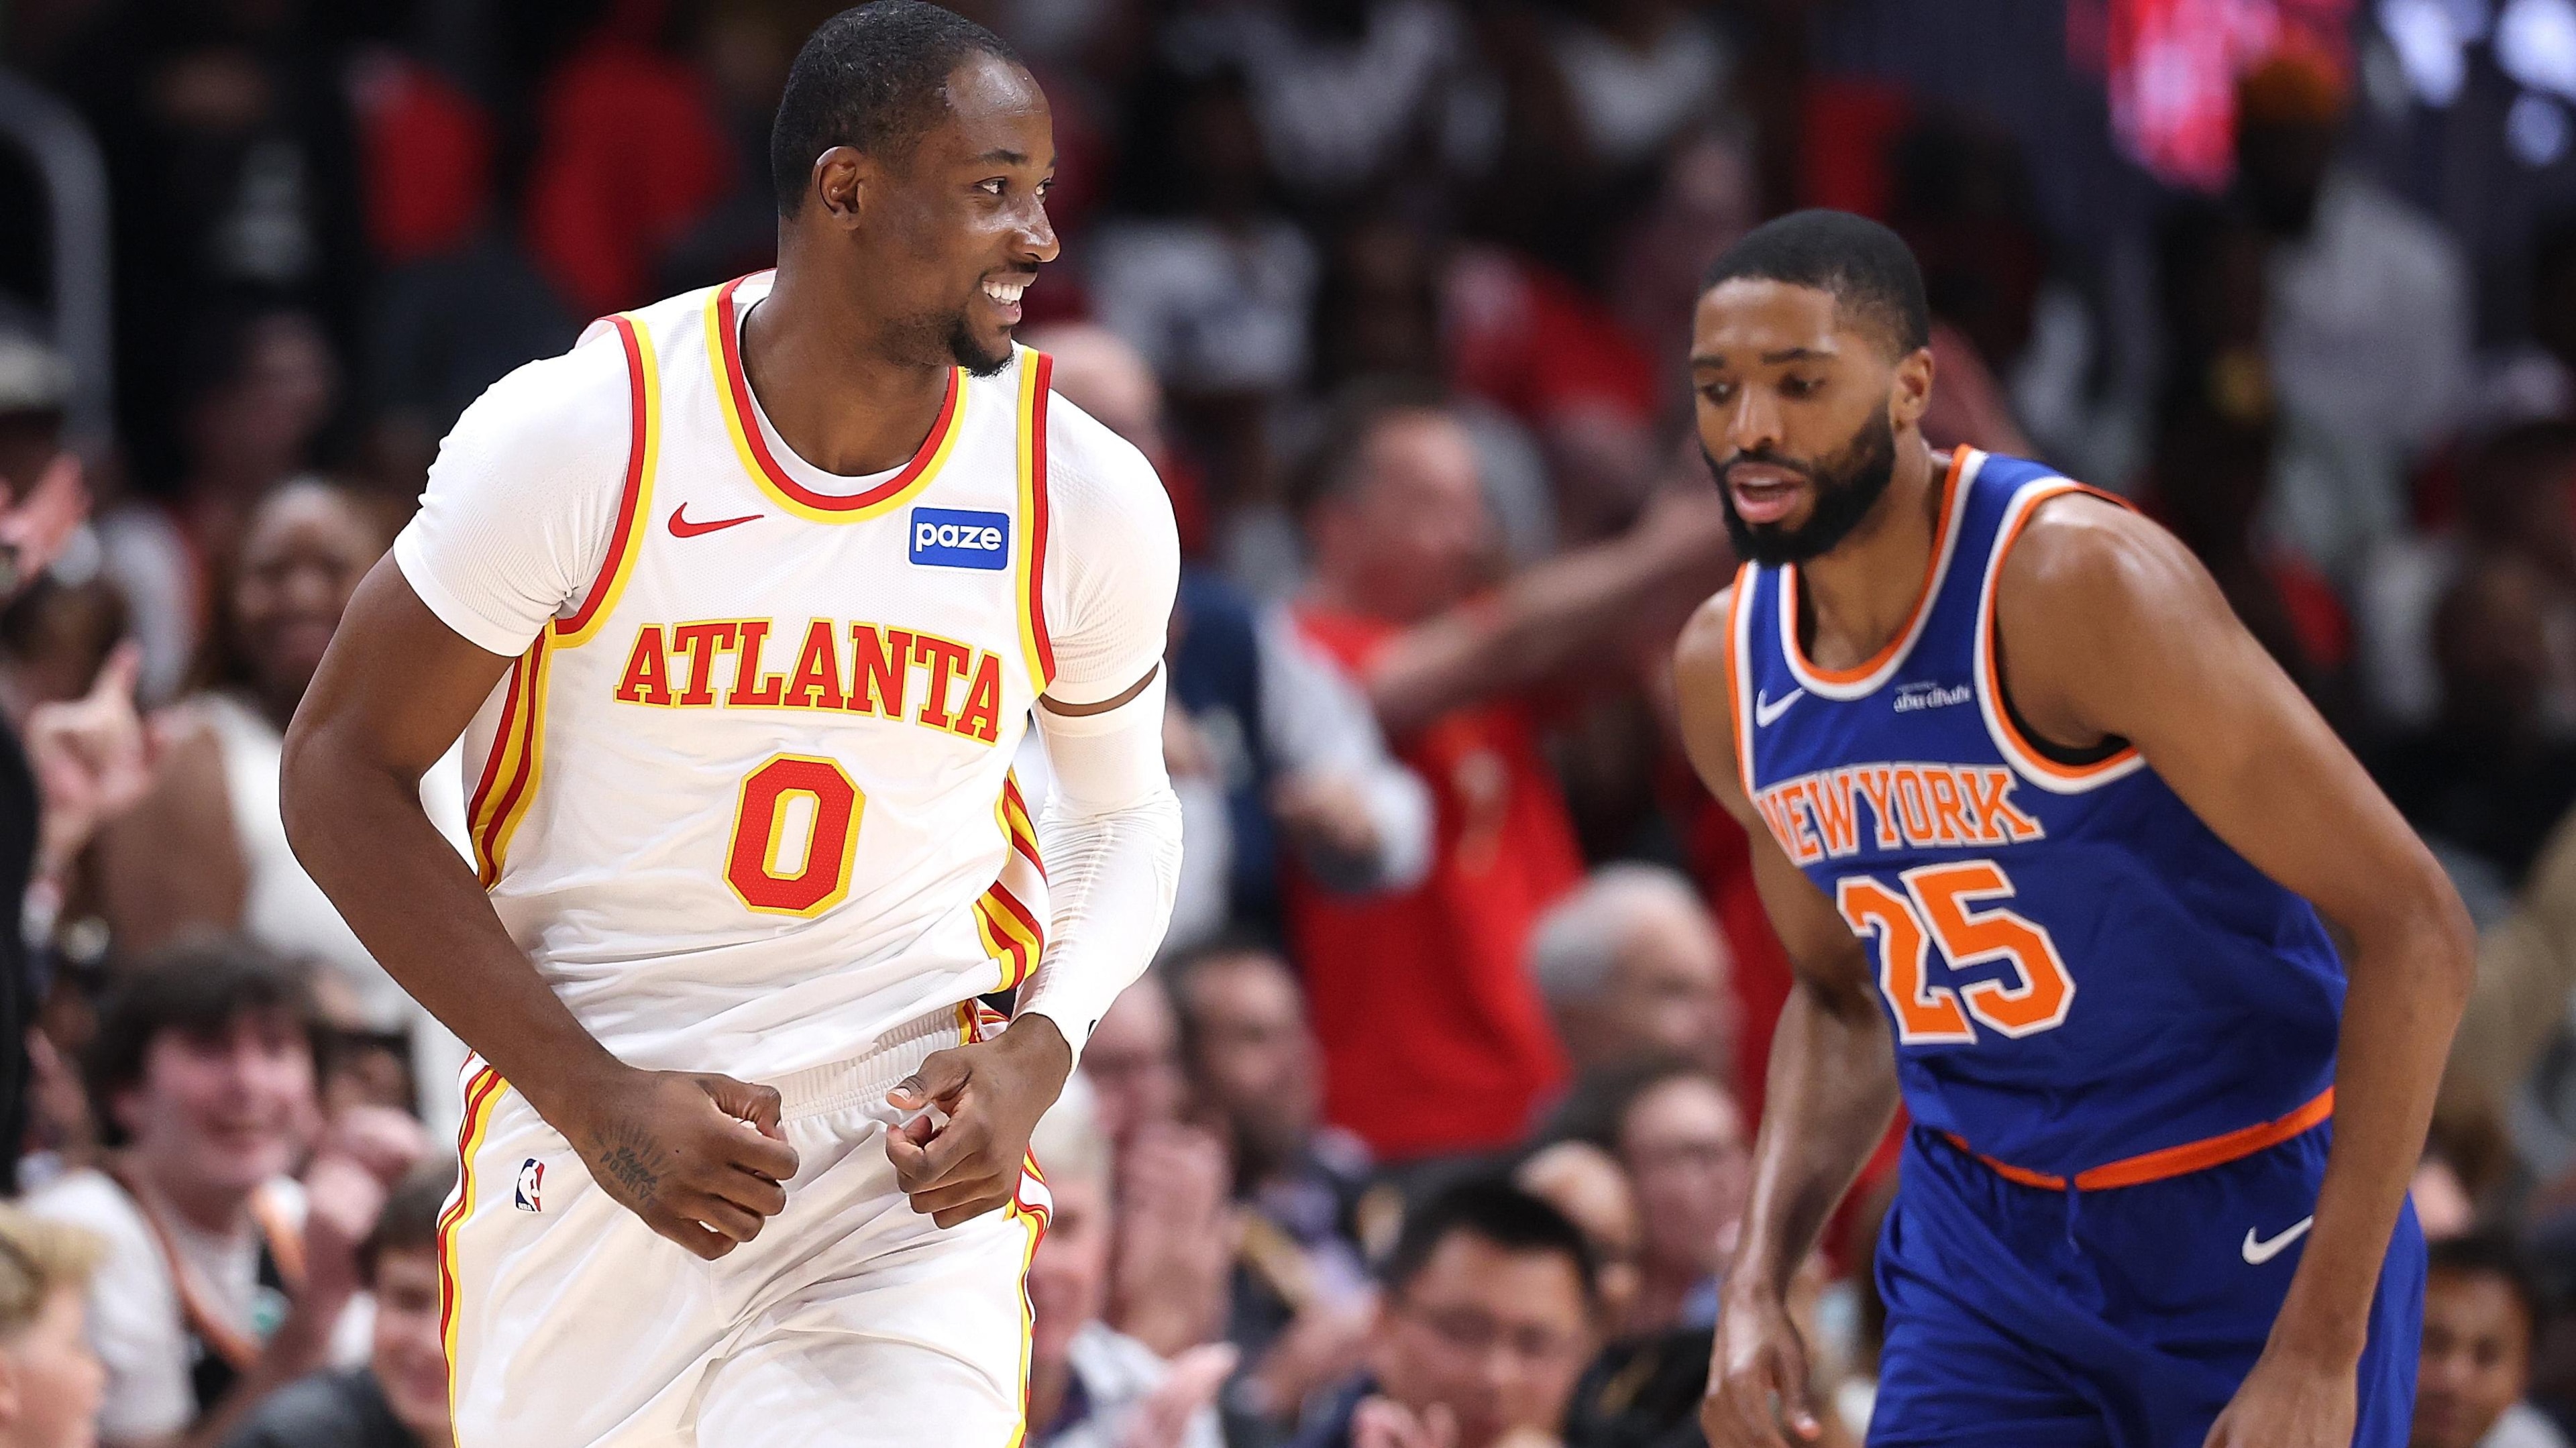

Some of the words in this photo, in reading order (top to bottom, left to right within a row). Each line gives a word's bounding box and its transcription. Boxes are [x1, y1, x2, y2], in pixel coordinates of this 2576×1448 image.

[915, 522, 1002, 553] paze
[613, 617, 1002, 747] ATLANTA
[722, 753, 866, 919] 0
[1856, 762, 2046, 850] YORK
[1836, 859, 2076, 1046] 25
